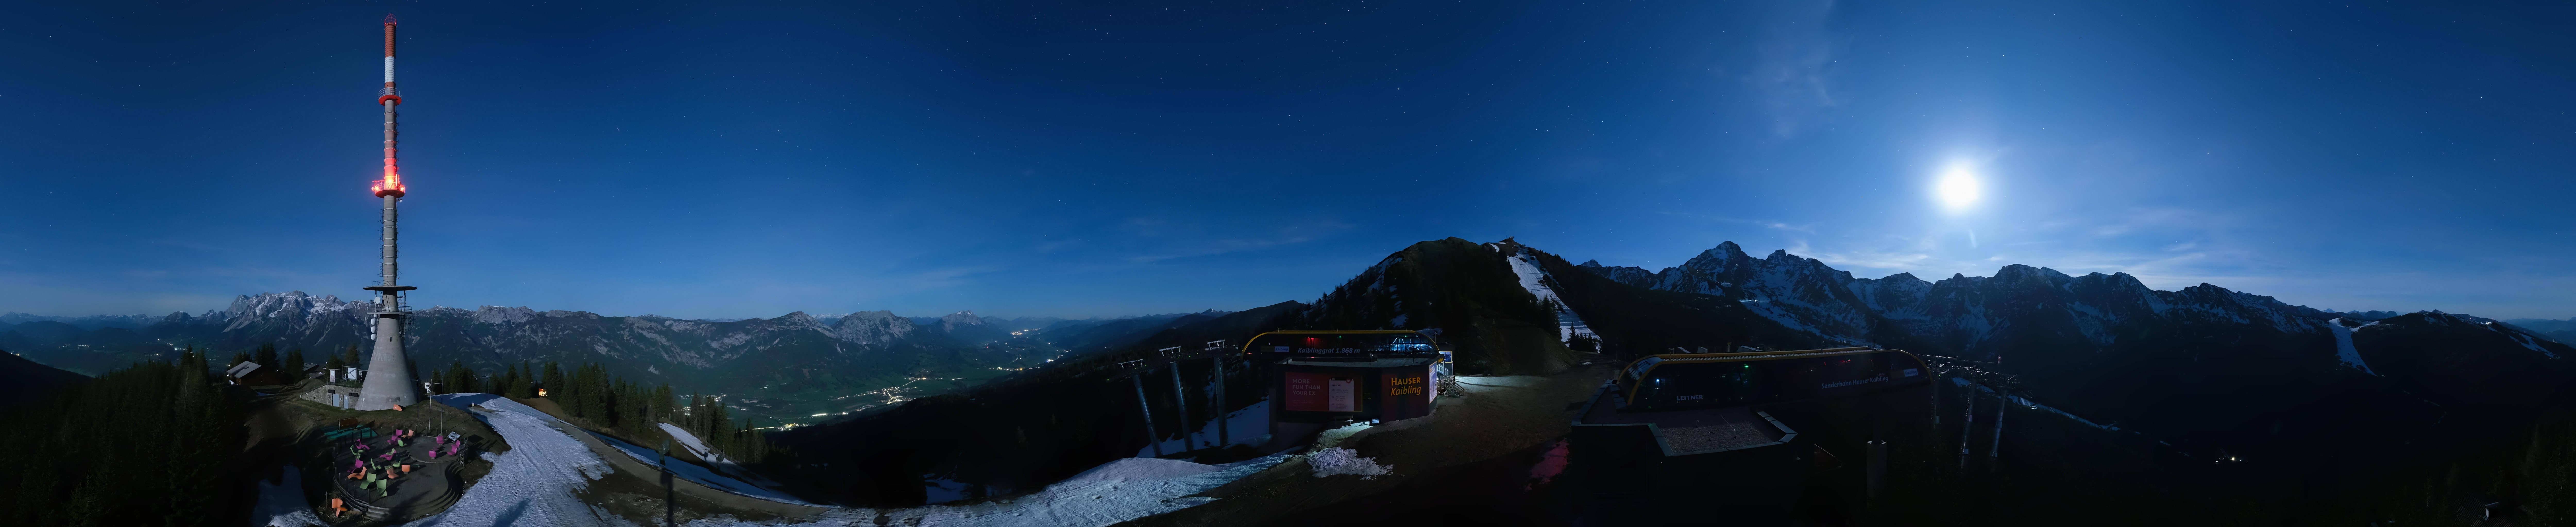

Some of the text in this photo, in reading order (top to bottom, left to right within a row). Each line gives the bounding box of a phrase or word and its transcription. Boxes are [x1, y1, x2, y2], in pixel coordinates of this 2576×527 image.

[1391, 377, 1421, 386] HAUSER
[1821, 380, 1852, 389] Senderbahn
[1391, 386, 1421, 396] Kaibling
